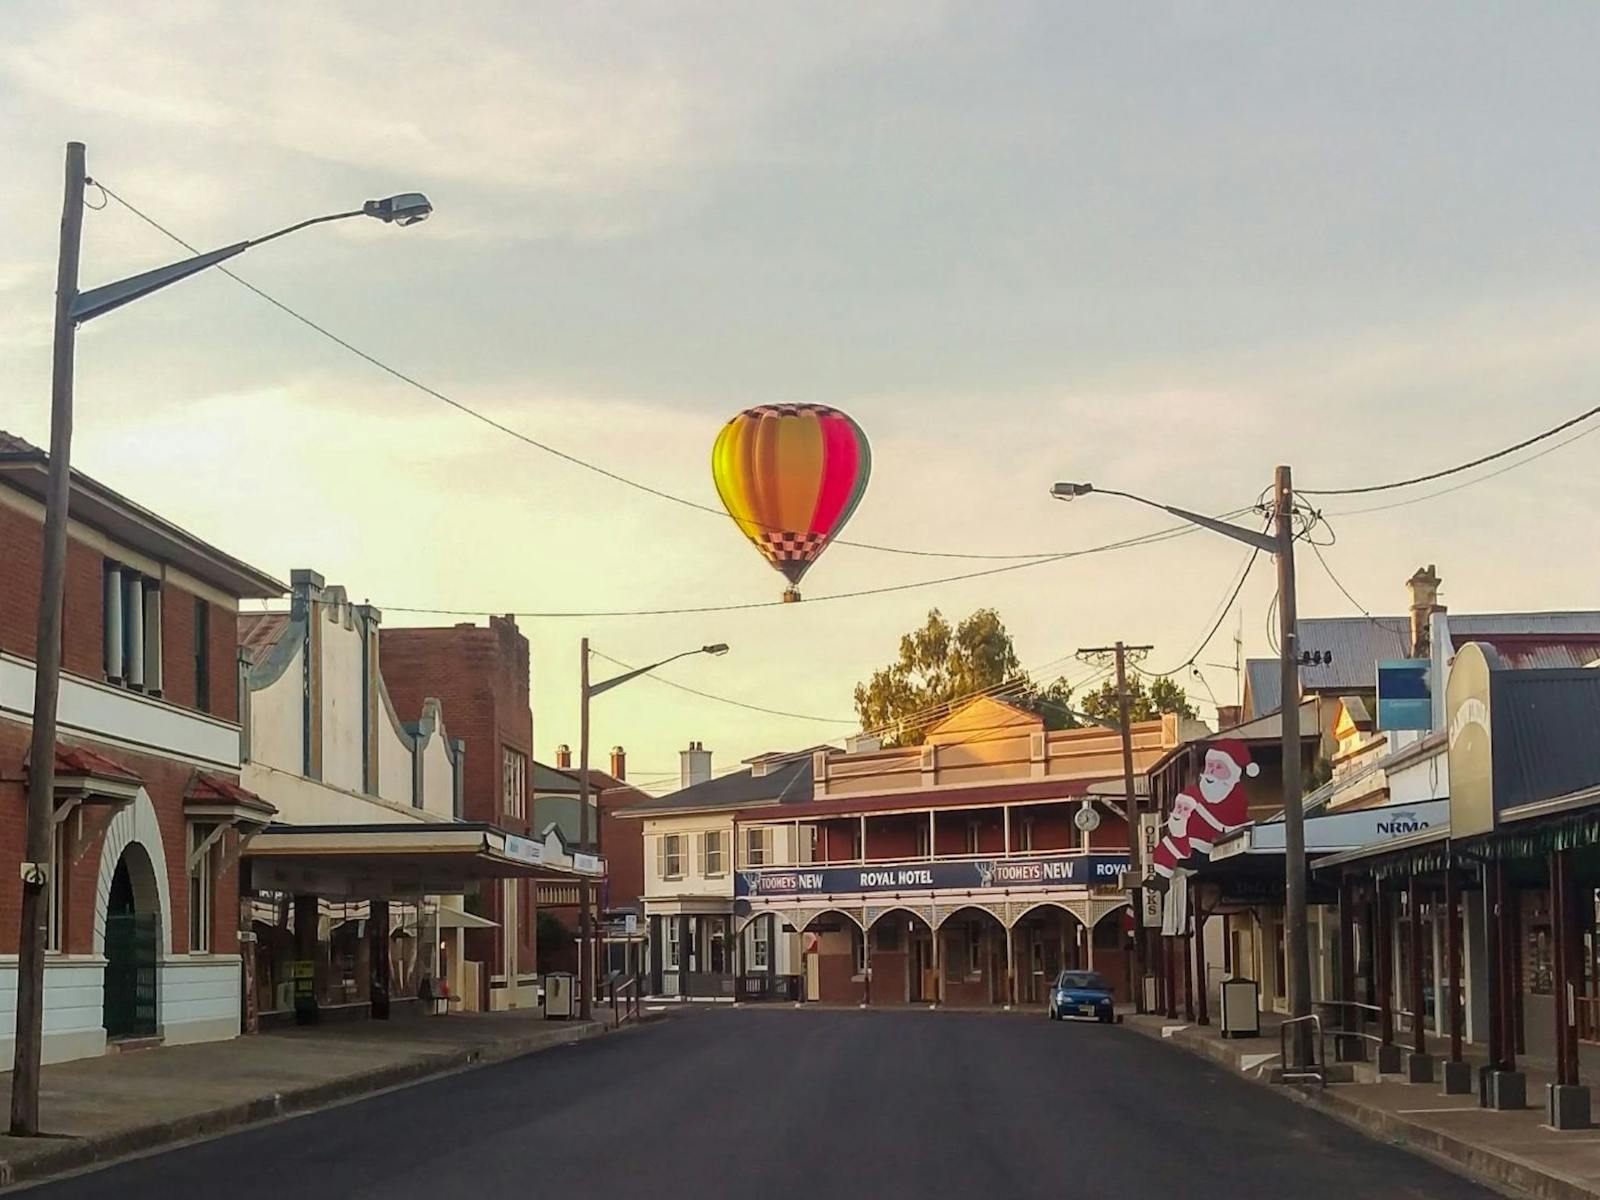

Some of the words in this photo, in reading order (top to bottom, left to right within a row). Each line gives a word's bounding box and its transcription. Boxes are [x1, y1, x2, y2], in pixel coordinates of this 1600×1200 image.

[1377, 821, 1430, 834] NRMA
[1145, 825, 1156, 854] OLD
[860, 873, 895, 887] ROYAL
[898, 870, 933, 885] HOTEL
[997, 864, 1040, 880] TOOHEYS
[1043, 861, 1074, 880] NEW
[761, 876, 797, 890] TOOHEYS
[798, 873, 824, 889] NEW
